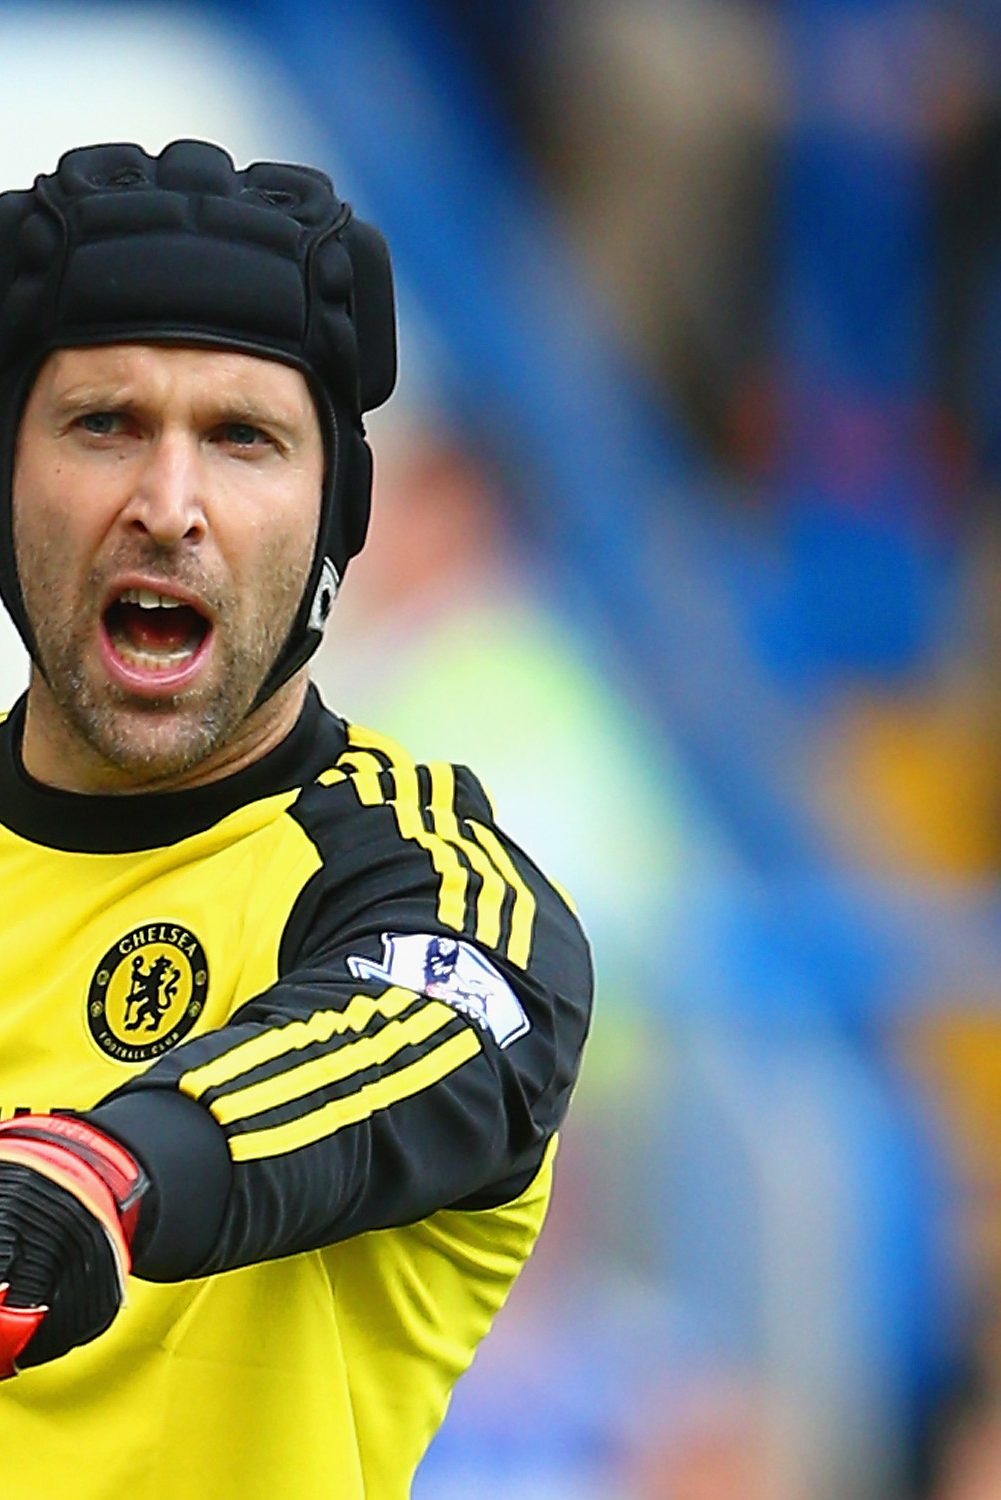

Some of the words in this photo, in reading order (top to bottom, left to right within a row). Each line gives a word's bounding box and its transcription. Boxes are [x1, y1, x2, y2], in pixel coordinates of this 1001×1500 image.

[119, 926, 199, 958] CHELSEA
[98, 1031, 145, 1060] FOOTBALL
[150, 1031, 180, 1054] CLUB
